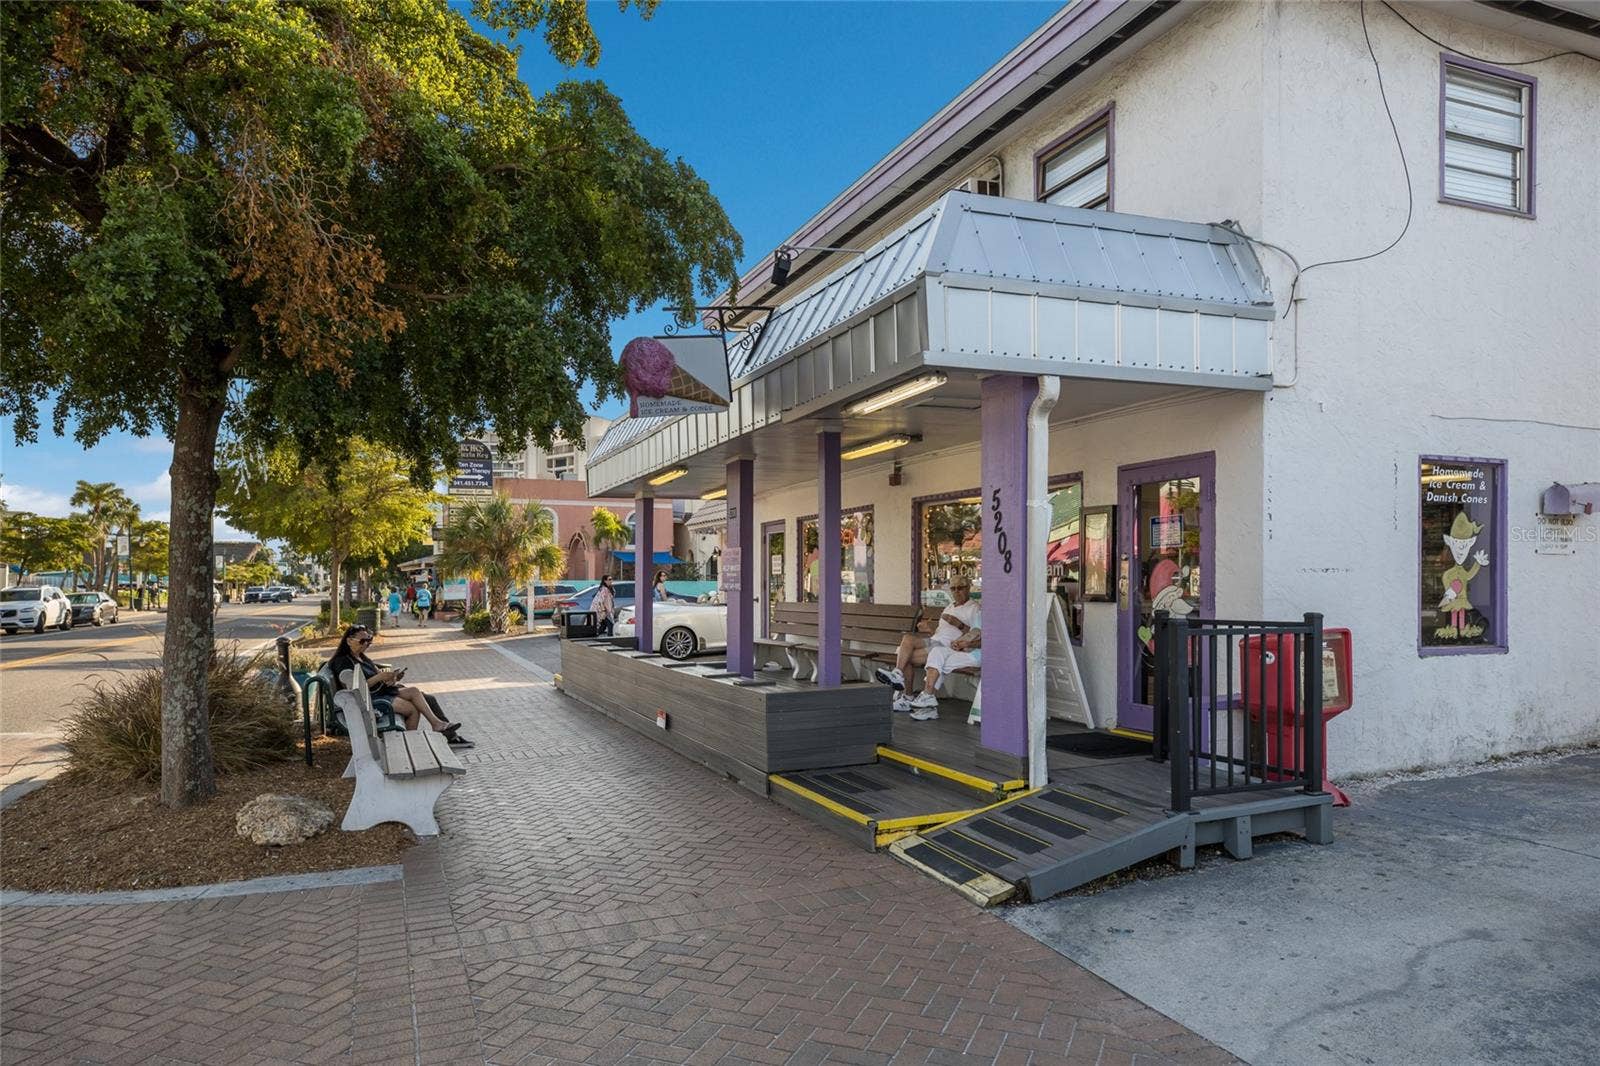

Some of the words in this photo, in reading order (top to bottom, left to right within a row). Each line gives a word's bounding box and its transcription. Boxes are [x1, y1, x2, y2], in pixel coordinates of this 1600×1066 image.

[640, 400, 681, 409] HOMEMADE
[641, 408, 654, 416] ICE
[655, 407, 680, 416] CREAM
[1432, 465, 1484, 479] Homemade
[1429, 480, 1443, 489] Ice
[1446, 480, 1476, 490] Cream
[1479, 480, 1487, 490] &
[1426, 491, 1458, 503] Danish
[1461, 493, 1488, 504] Cones
[991, 487, 1012, 574] 5208
